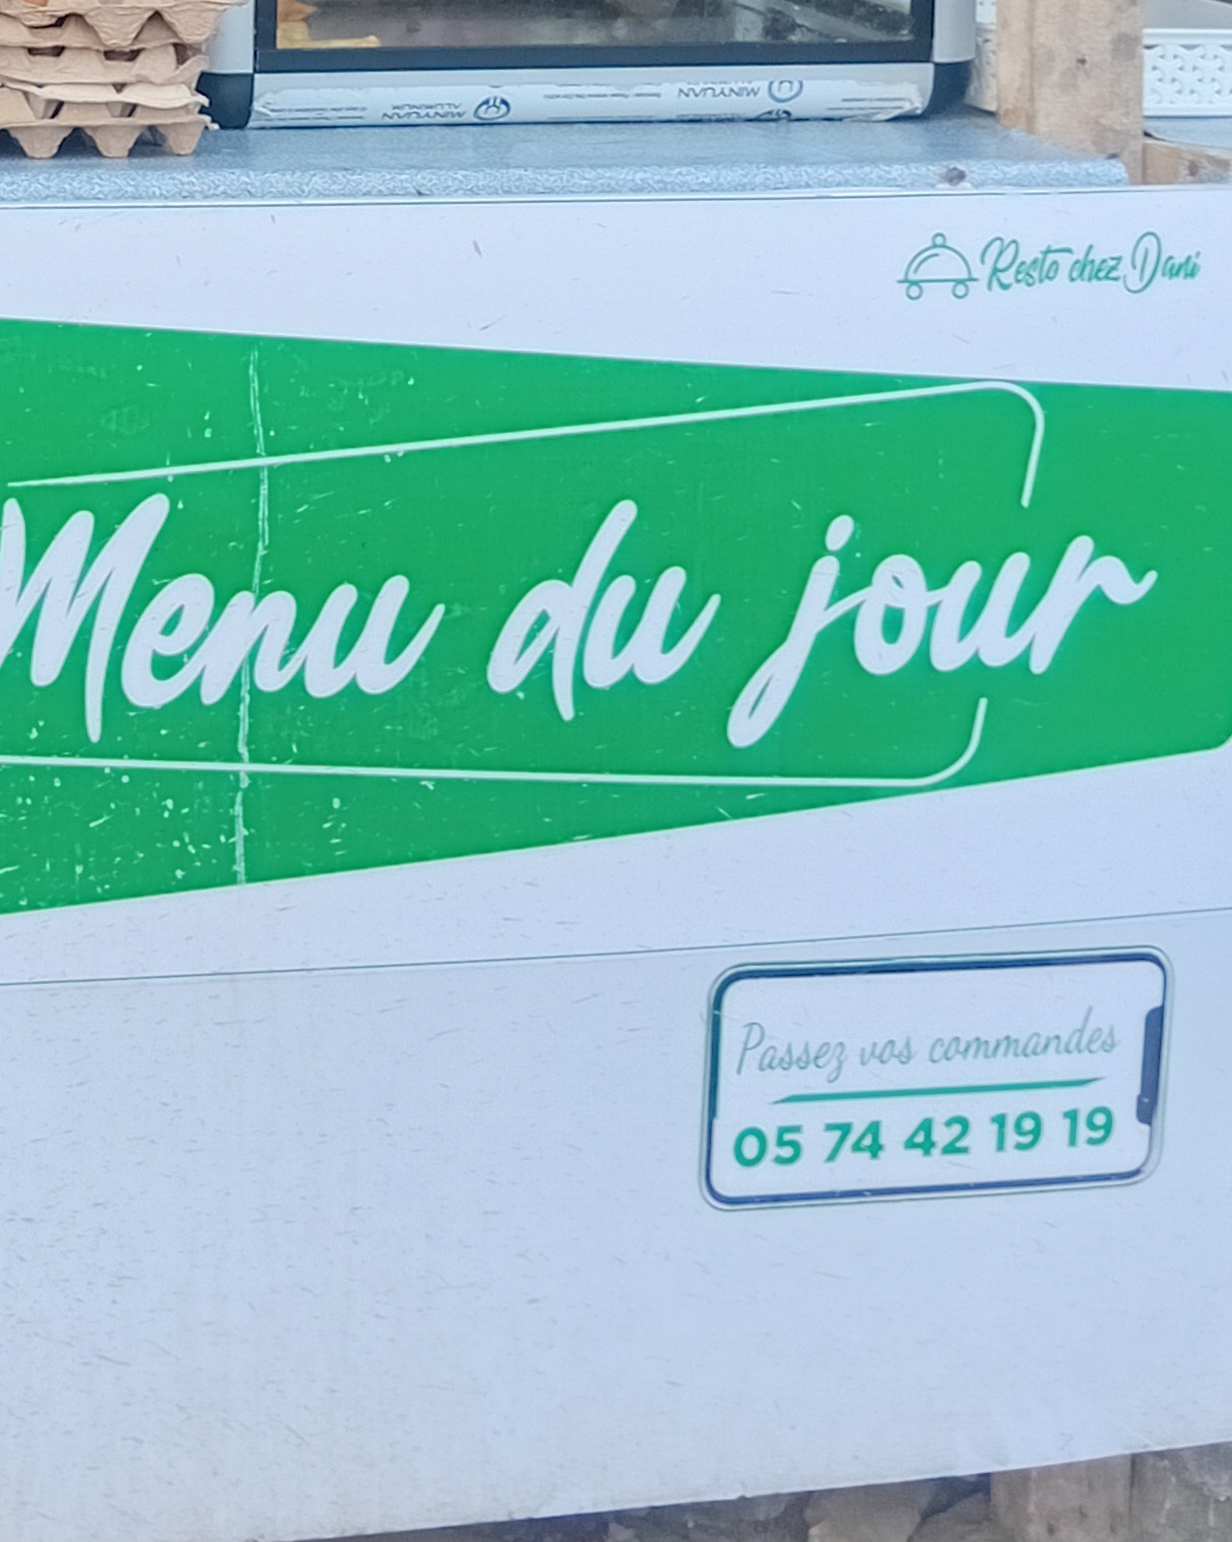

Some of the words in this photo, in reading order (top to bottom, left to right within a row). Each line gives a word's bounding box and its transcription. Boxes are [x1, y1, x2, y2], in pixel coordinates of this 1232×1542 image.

[979, 236, 1074, 292] Resto
[1067, 243, 1123, 284] chez
[1122, 231, 1201, 294] Dani
[485, 498, 722, 722] du
[726, 513, 1159, 749] jour
[735, 1022, 849, 1084] Passez
[860, 1033, 917, 1067] vos
[928, 1005, 1122, 1065] commandes
[732, 1124, 804, 1168] 05
[823, 1120, 884, 1164] 74
[903, 1114, 970, 1158] 42
[990, 1110, 1043, 1153] 19
[1062, 1106, 1115, 1149] 19
